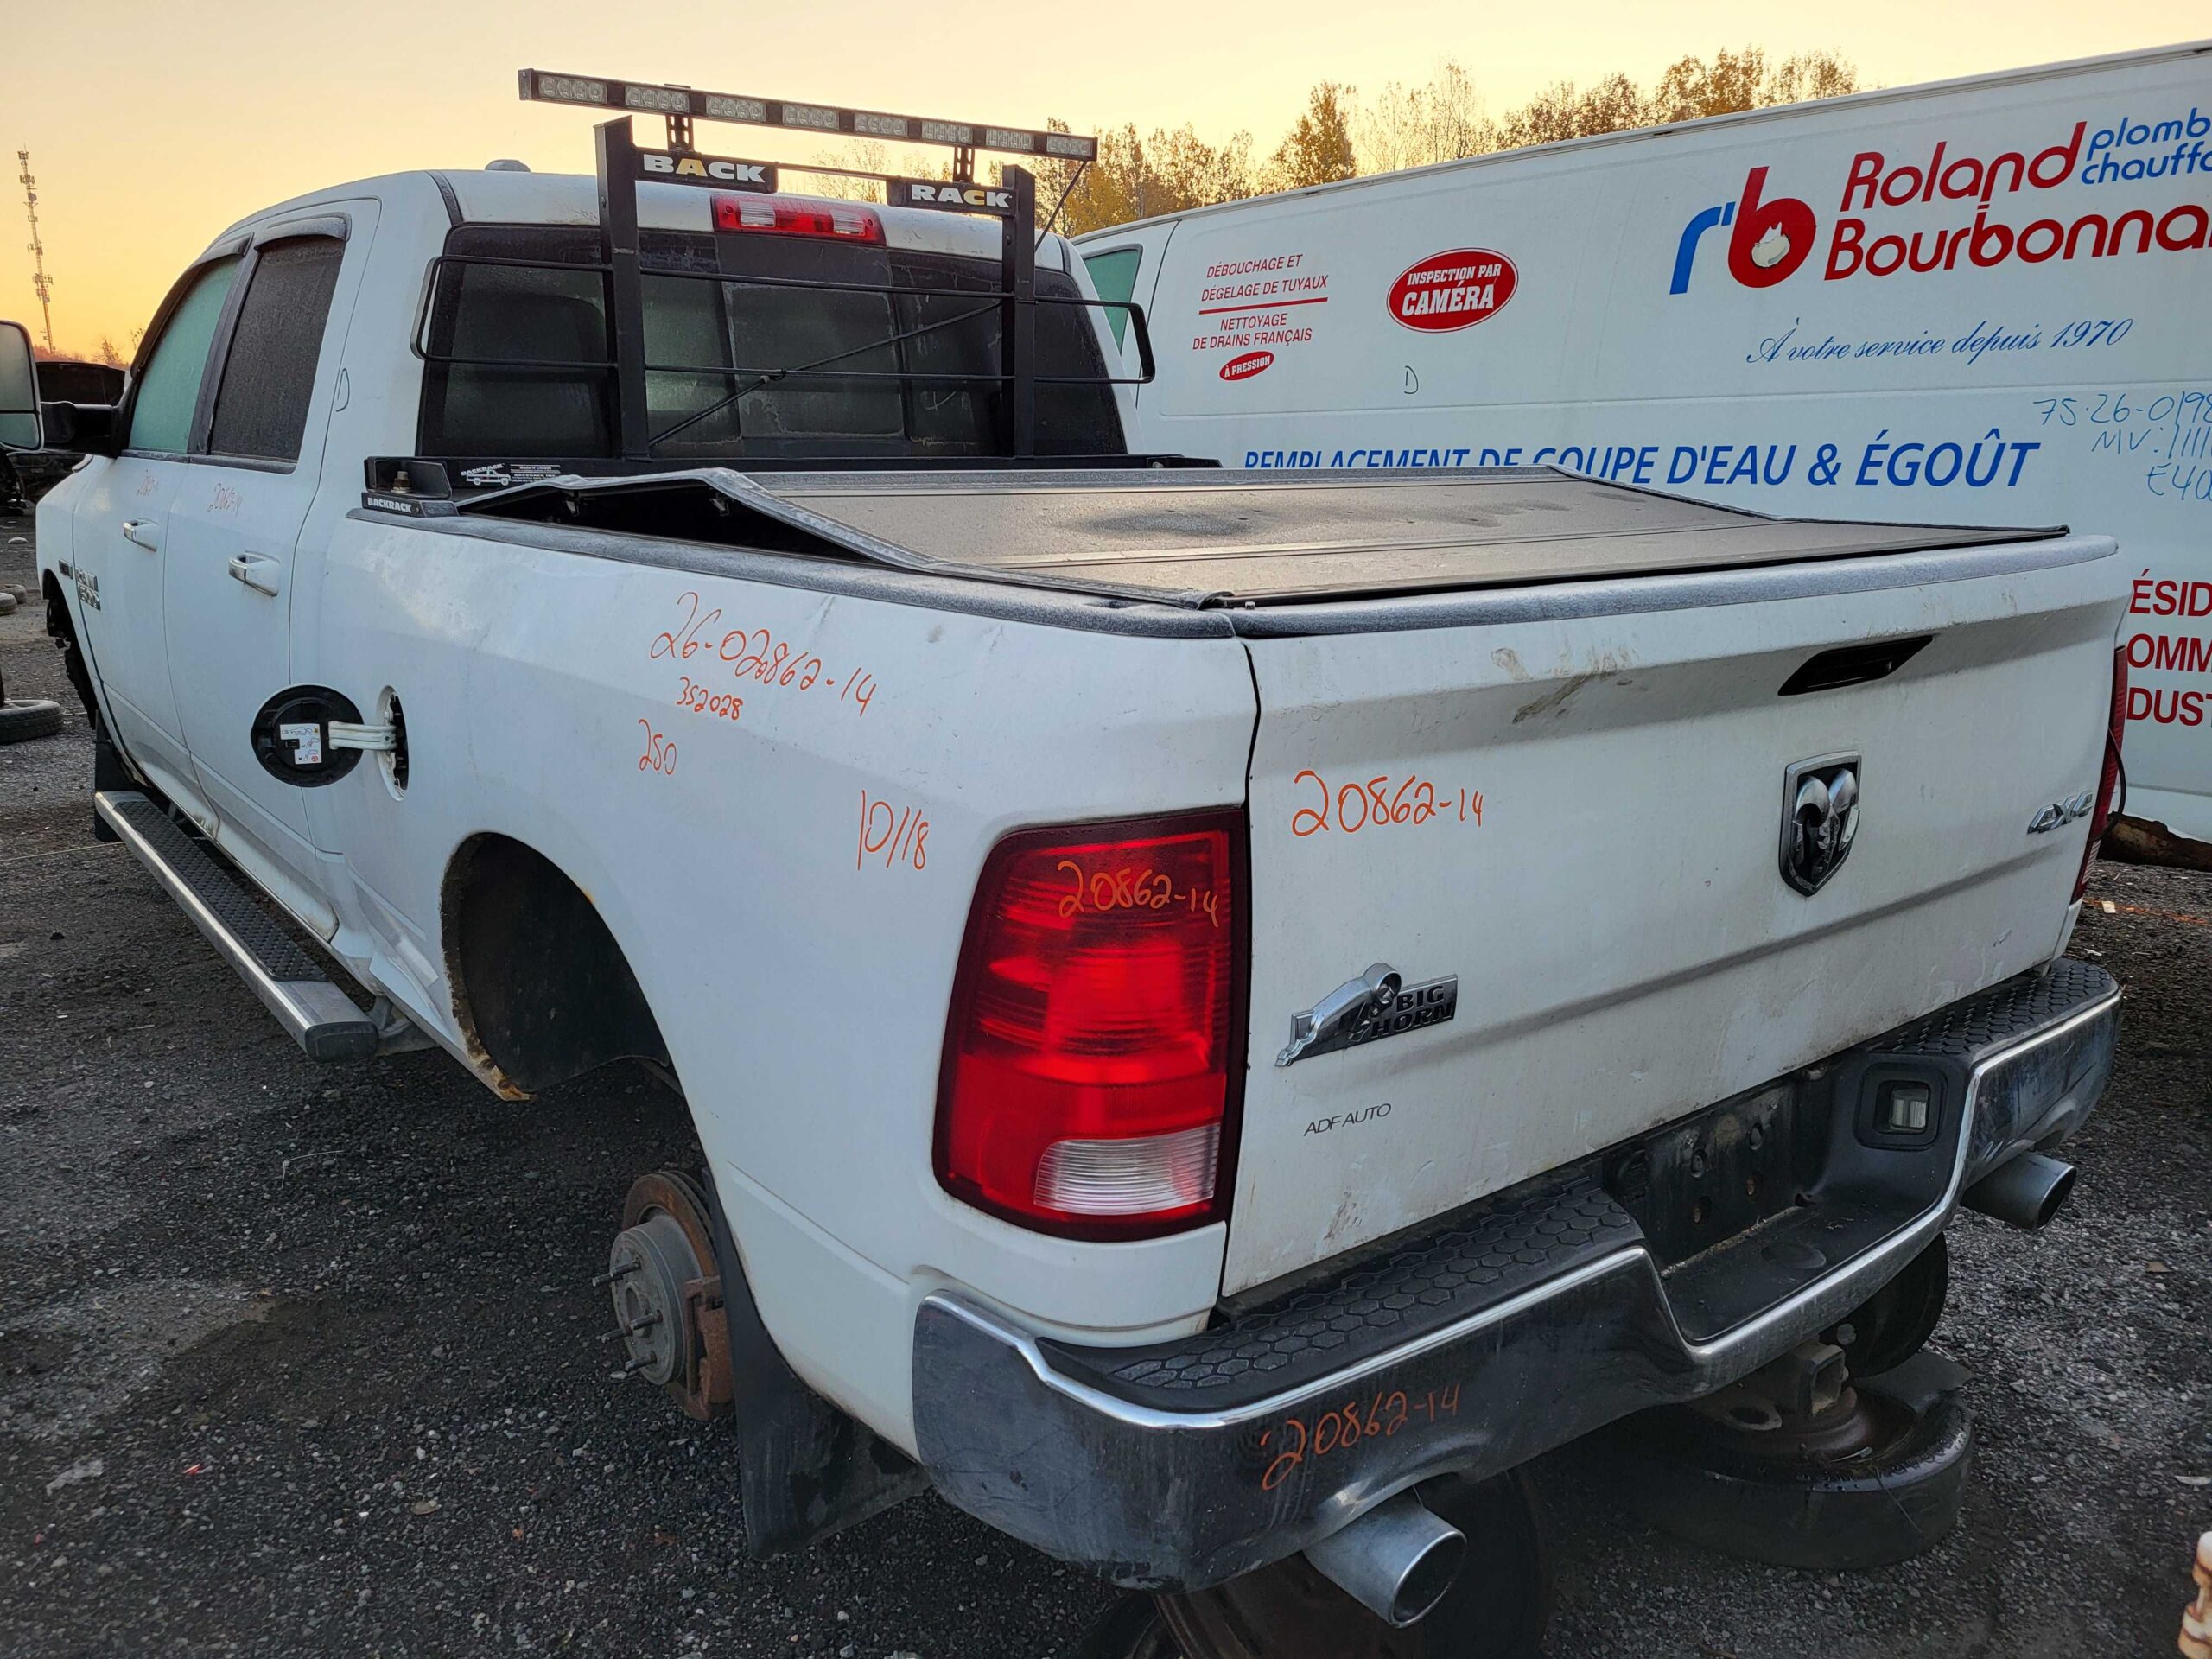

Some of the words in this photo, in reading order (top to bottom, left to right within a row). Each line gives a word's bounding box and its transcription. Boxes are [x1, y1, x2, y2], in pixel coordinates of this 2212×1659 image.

[2087, 107, 2212, 162] plomb
[643, 154, 766, 183] BACK
[912, 183, 1010, 208] RACK
[1840, 121, 2088, 212] Roland
[1824, 204, 2212, 281] Bourbonna
[1206, 256, 1285, 278] DÉBOUCHAGE
[1287, 254, 1303, 268] ET
[1407, 266, 1476, 286] INSPECTION
[1477, 263, 1502, 278] PAR
[1201, 283, 1260, 302] DÉGELAGE
[1262, 281, 1279, 295] DE
[1282, 275, 1328, 293] TUYAUX
[1402, 280, 1494, 316] CAMÉRA
[1192, 337, 1207, 350] DE
[1210, 334, 1250, 348] DRAINS
[1254, 327, 1312, 346] FRANÇAIS
[1220, 313, 1287, 331] NETTOYAGE
[1789, 336, 1849, 361] votre
[1853, 329, 1946, 359] service
[1951, 320, 2043, 365] depuis
[2049, 317, 2134, 349] 1970
[1231, 355, 1270, 376] PRESSION
[1666, 444, 1797, 486] D'EAU
[1808, 443, 1842, 486] &
[1854, 428, 2042, 488] ÉGOÛT
[367, 498, 412, 513] BACKRACK
[2126, 687, 2212, 726] DUS
[1292, 770, 1484, 836] 20862-14
[1058, 860, 1219, 928] 20862-14
[1395, 985, 1445, 1013] BIG
[1370, 1002, 1453, 1039] HORN
[1303, 1115, 1342, 1137] ADF
[1341, 1103, 1392, 1128] AUTO
